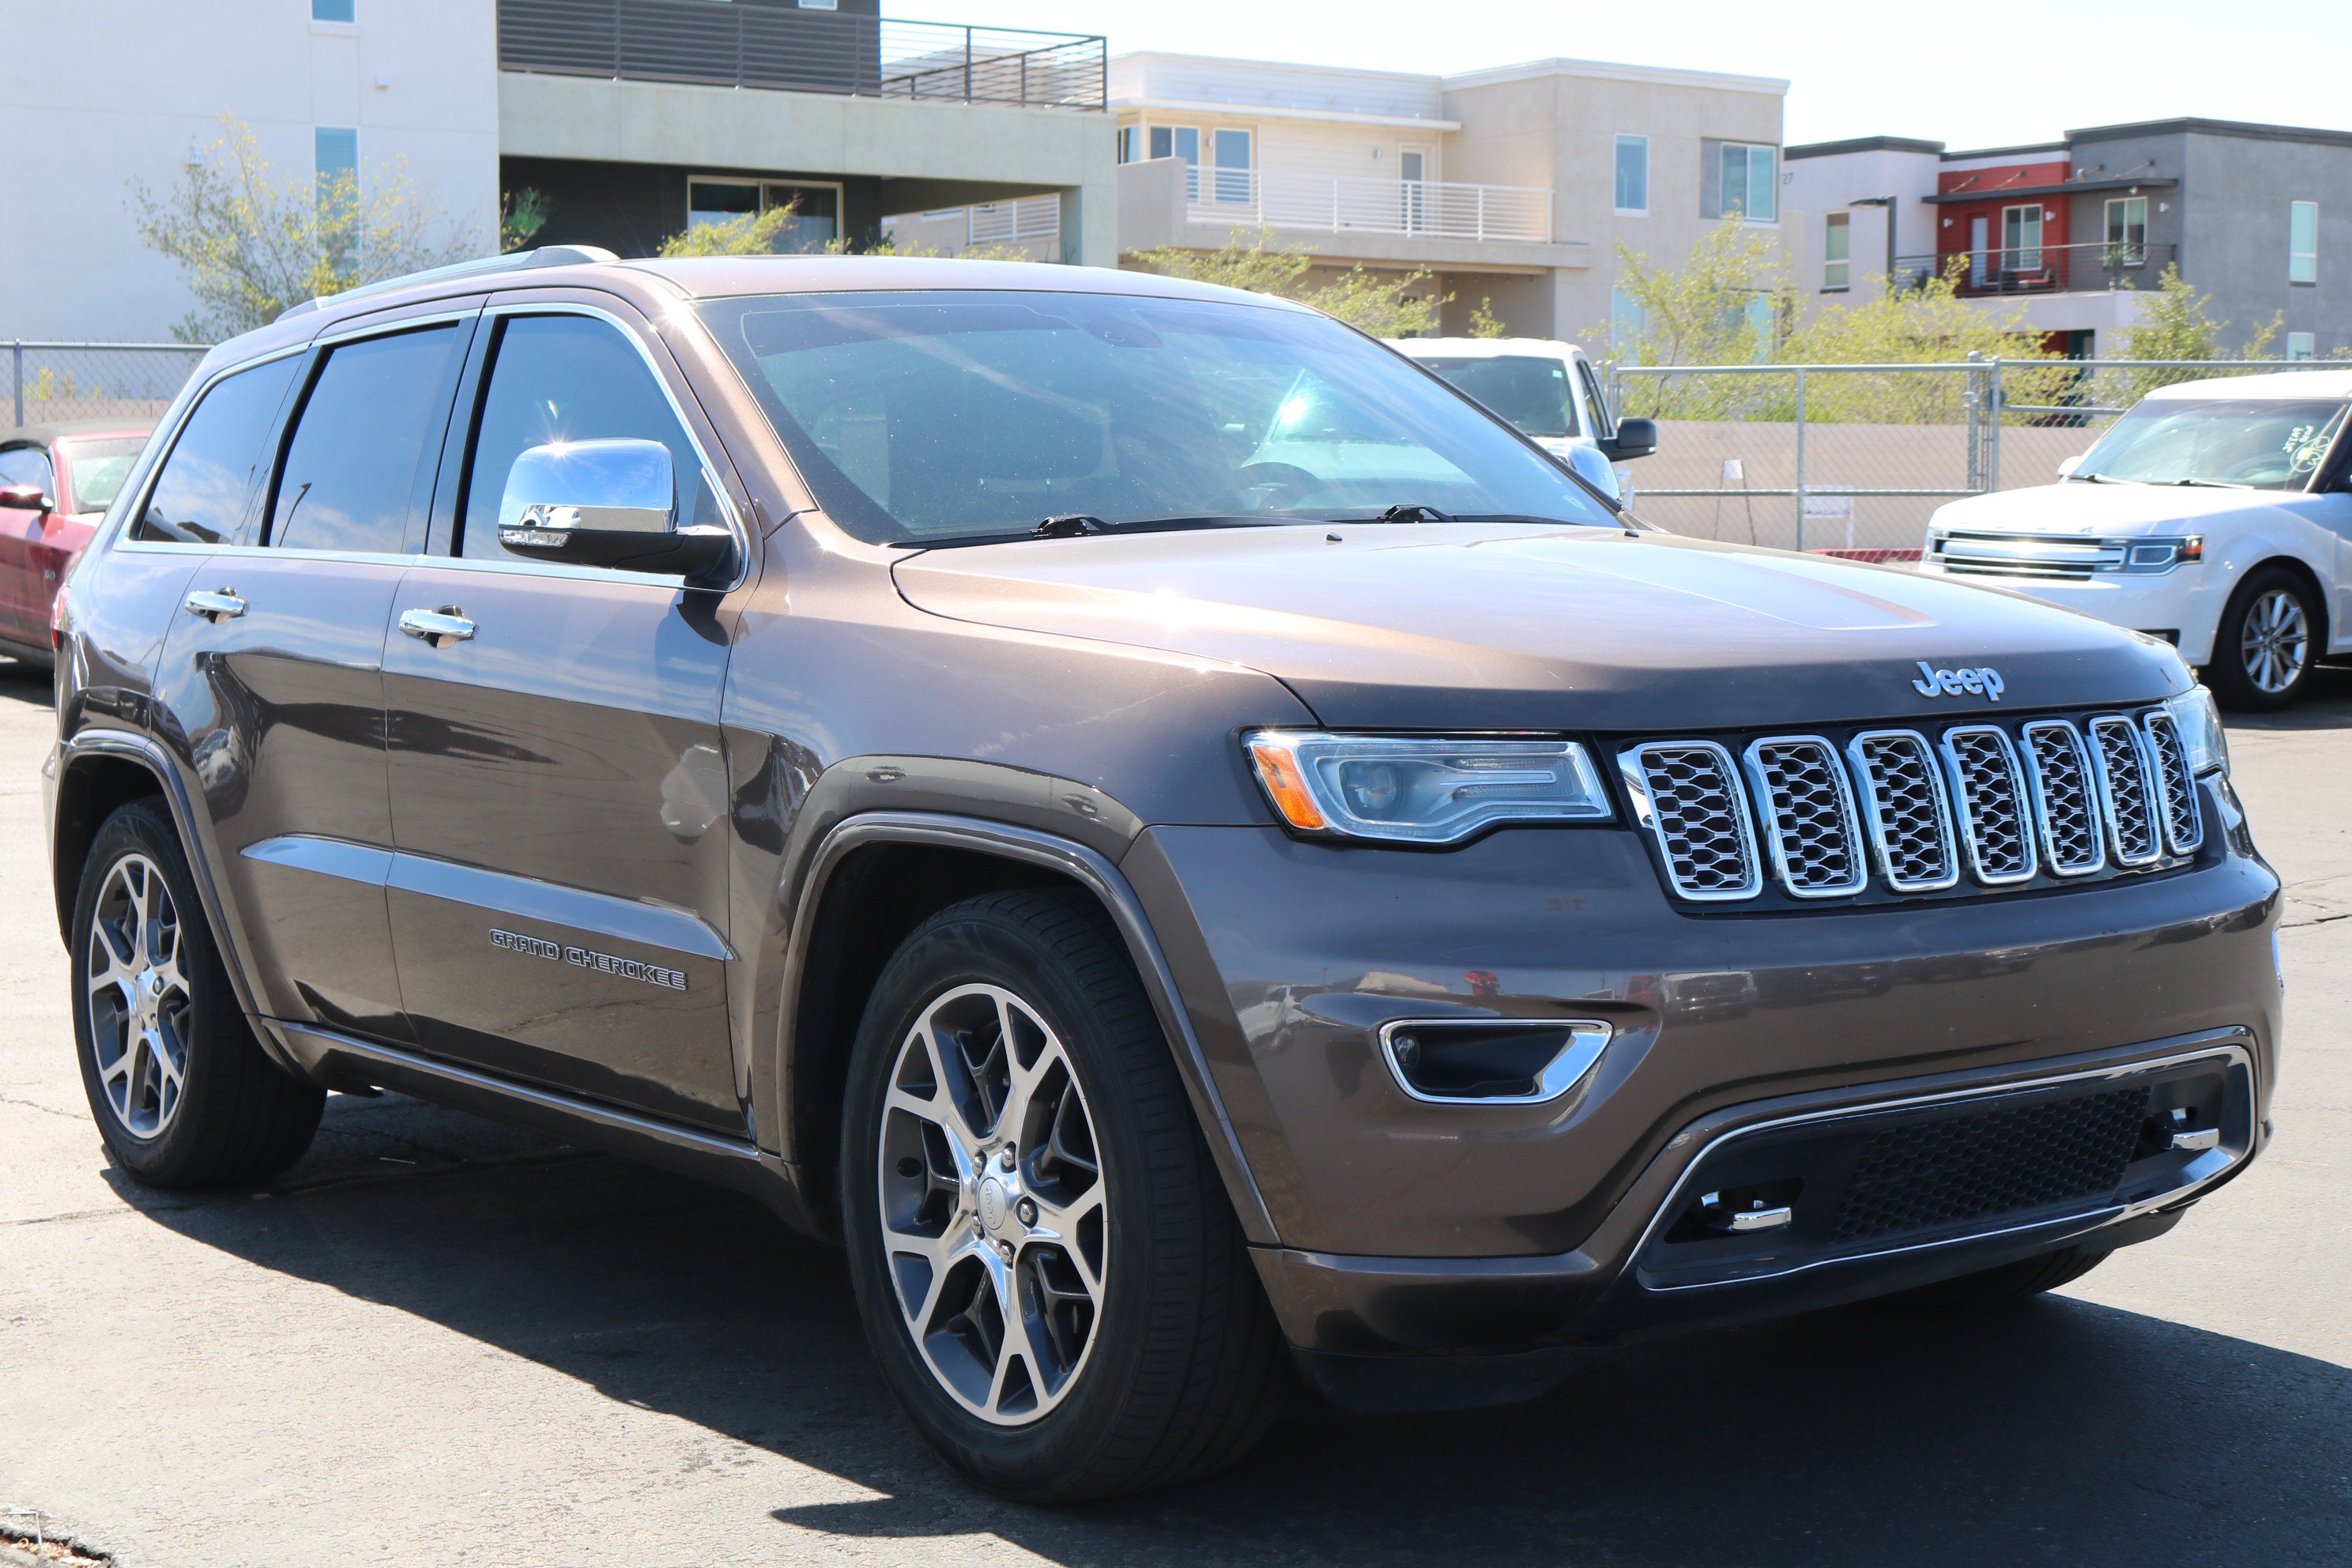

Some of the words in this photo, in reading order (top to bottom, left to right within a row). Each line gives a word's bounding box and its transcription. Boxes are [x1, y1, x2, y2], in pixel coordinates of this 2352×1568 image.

[1911, 661, 2005, 703] Jeep
[488, 928, 563, 961] GRAND
[564, 945, 689, 991] CHEROKEE
[985, 1184, 997, 1225] Jeep
